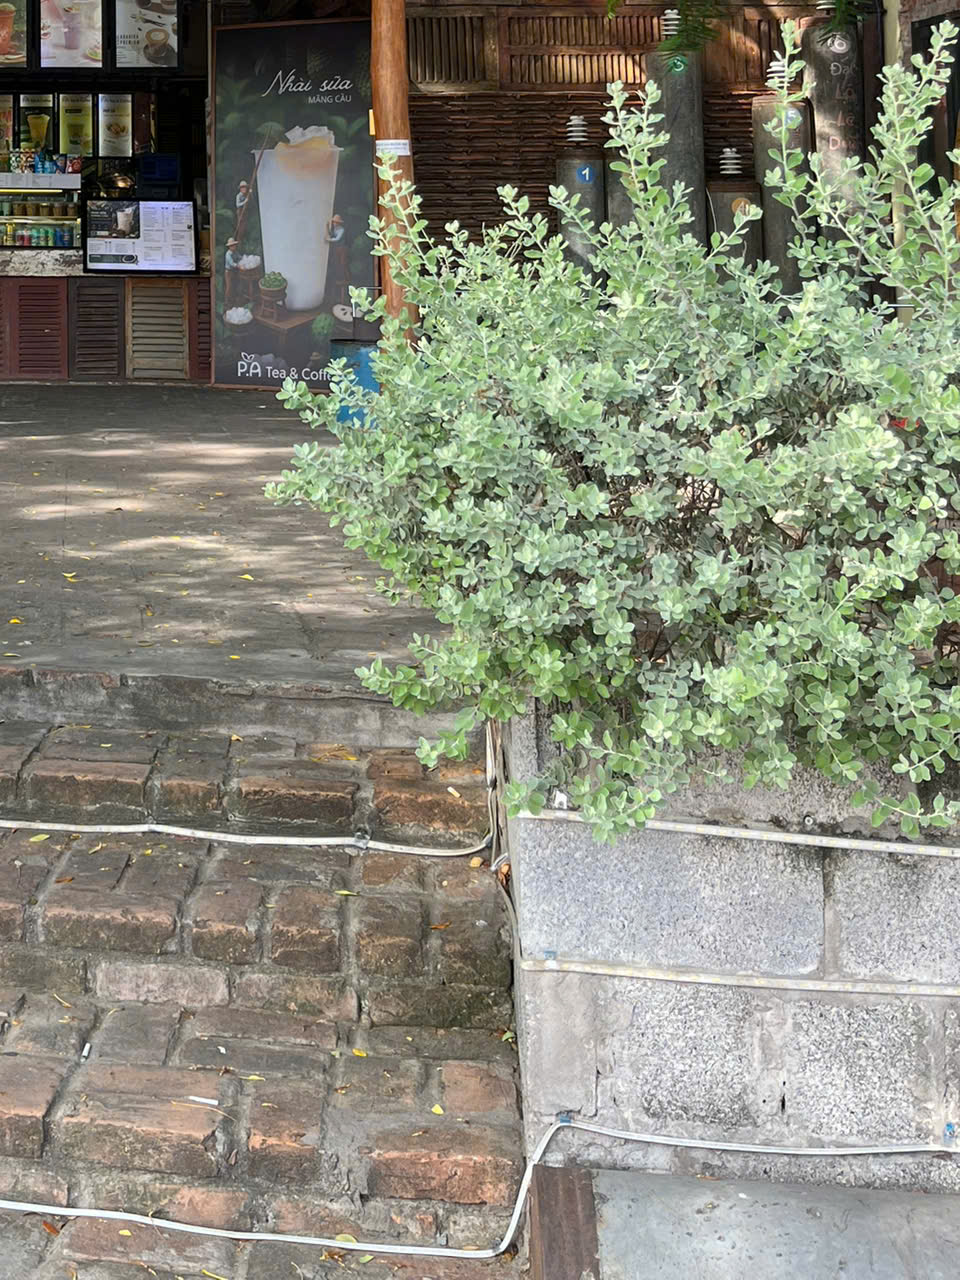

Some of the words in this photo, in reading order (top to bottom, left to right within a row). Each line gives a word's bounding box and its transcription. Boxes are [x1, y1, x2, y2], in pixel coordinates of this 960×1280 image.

[261, 68, 313, 97] Nhài
[319, 75, 354, 92] sữa
[581, 167, 590, 181] 1
[237, 361, 262, 378] P.A
[265, 366, 287, 379] Tea
[289, 367, 299, 380] &
